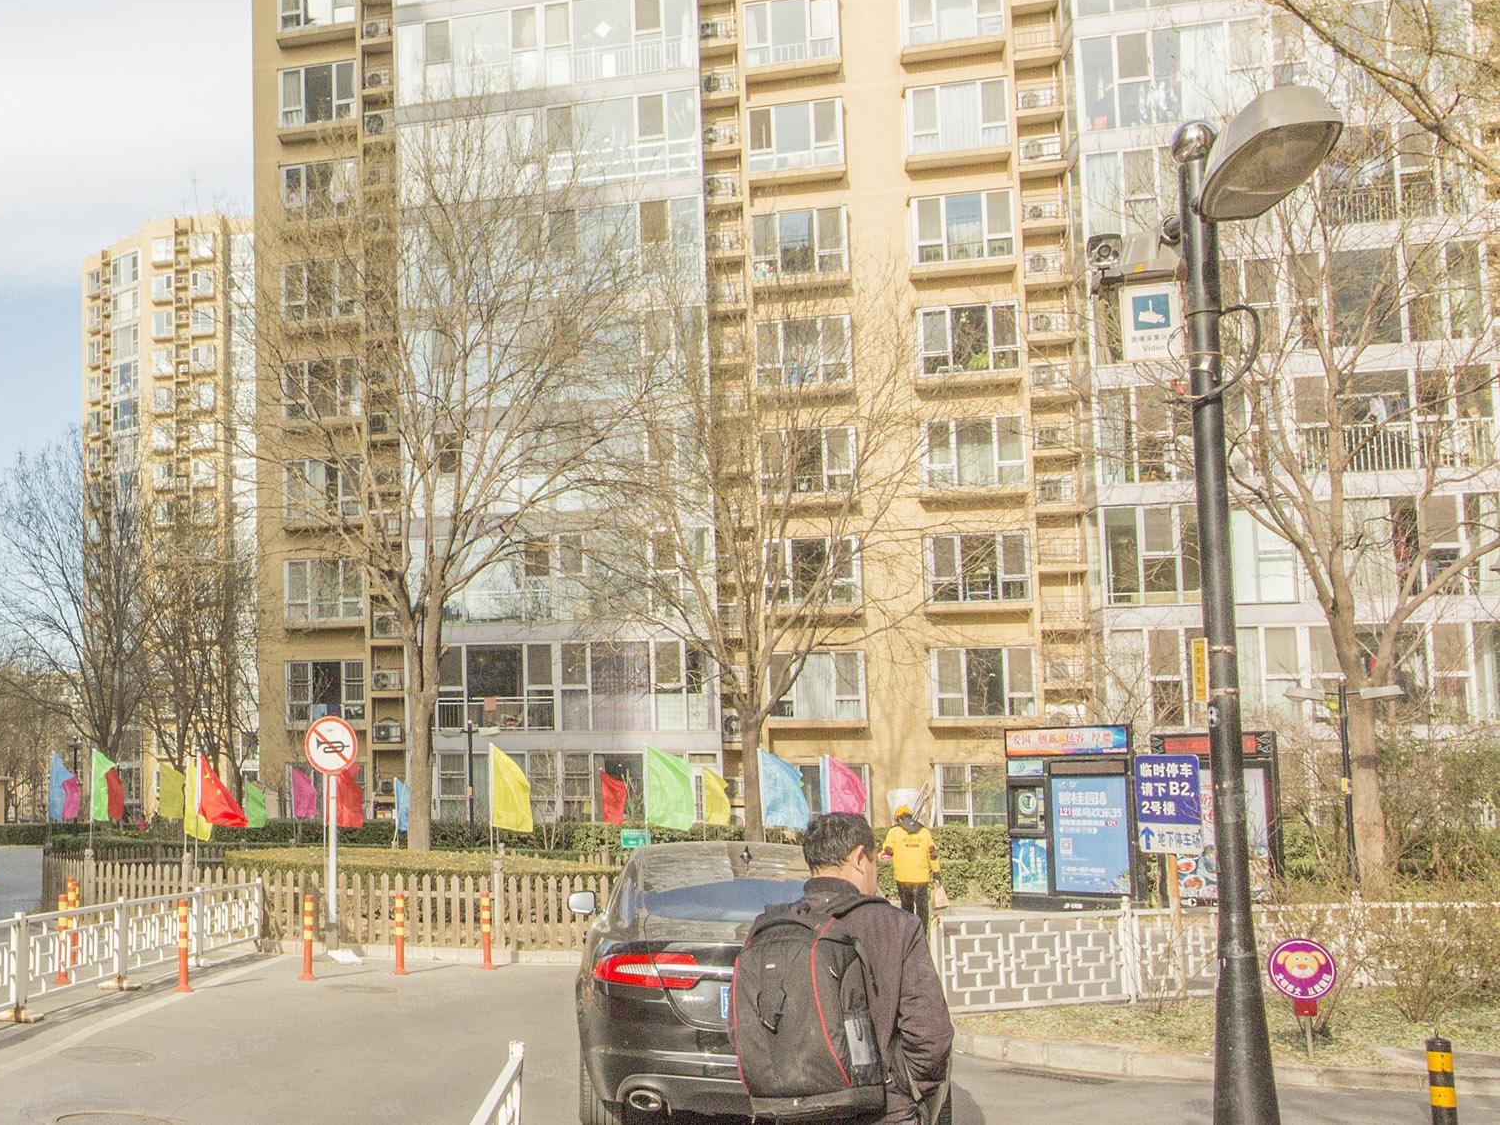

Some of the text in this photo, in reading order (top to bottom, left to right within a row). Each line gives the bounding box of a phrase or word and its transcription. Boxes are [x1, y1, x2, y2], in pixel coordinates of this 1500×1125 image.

[1142, 344, 1166, 352] Video
[1037, 733, 1057, 744] 创新
[1139, 763, 1193, 778] 临时停车
[1141, 801, 1176, 816] 2号楼
[1157, 830, 1202, 849] 地下停车场
